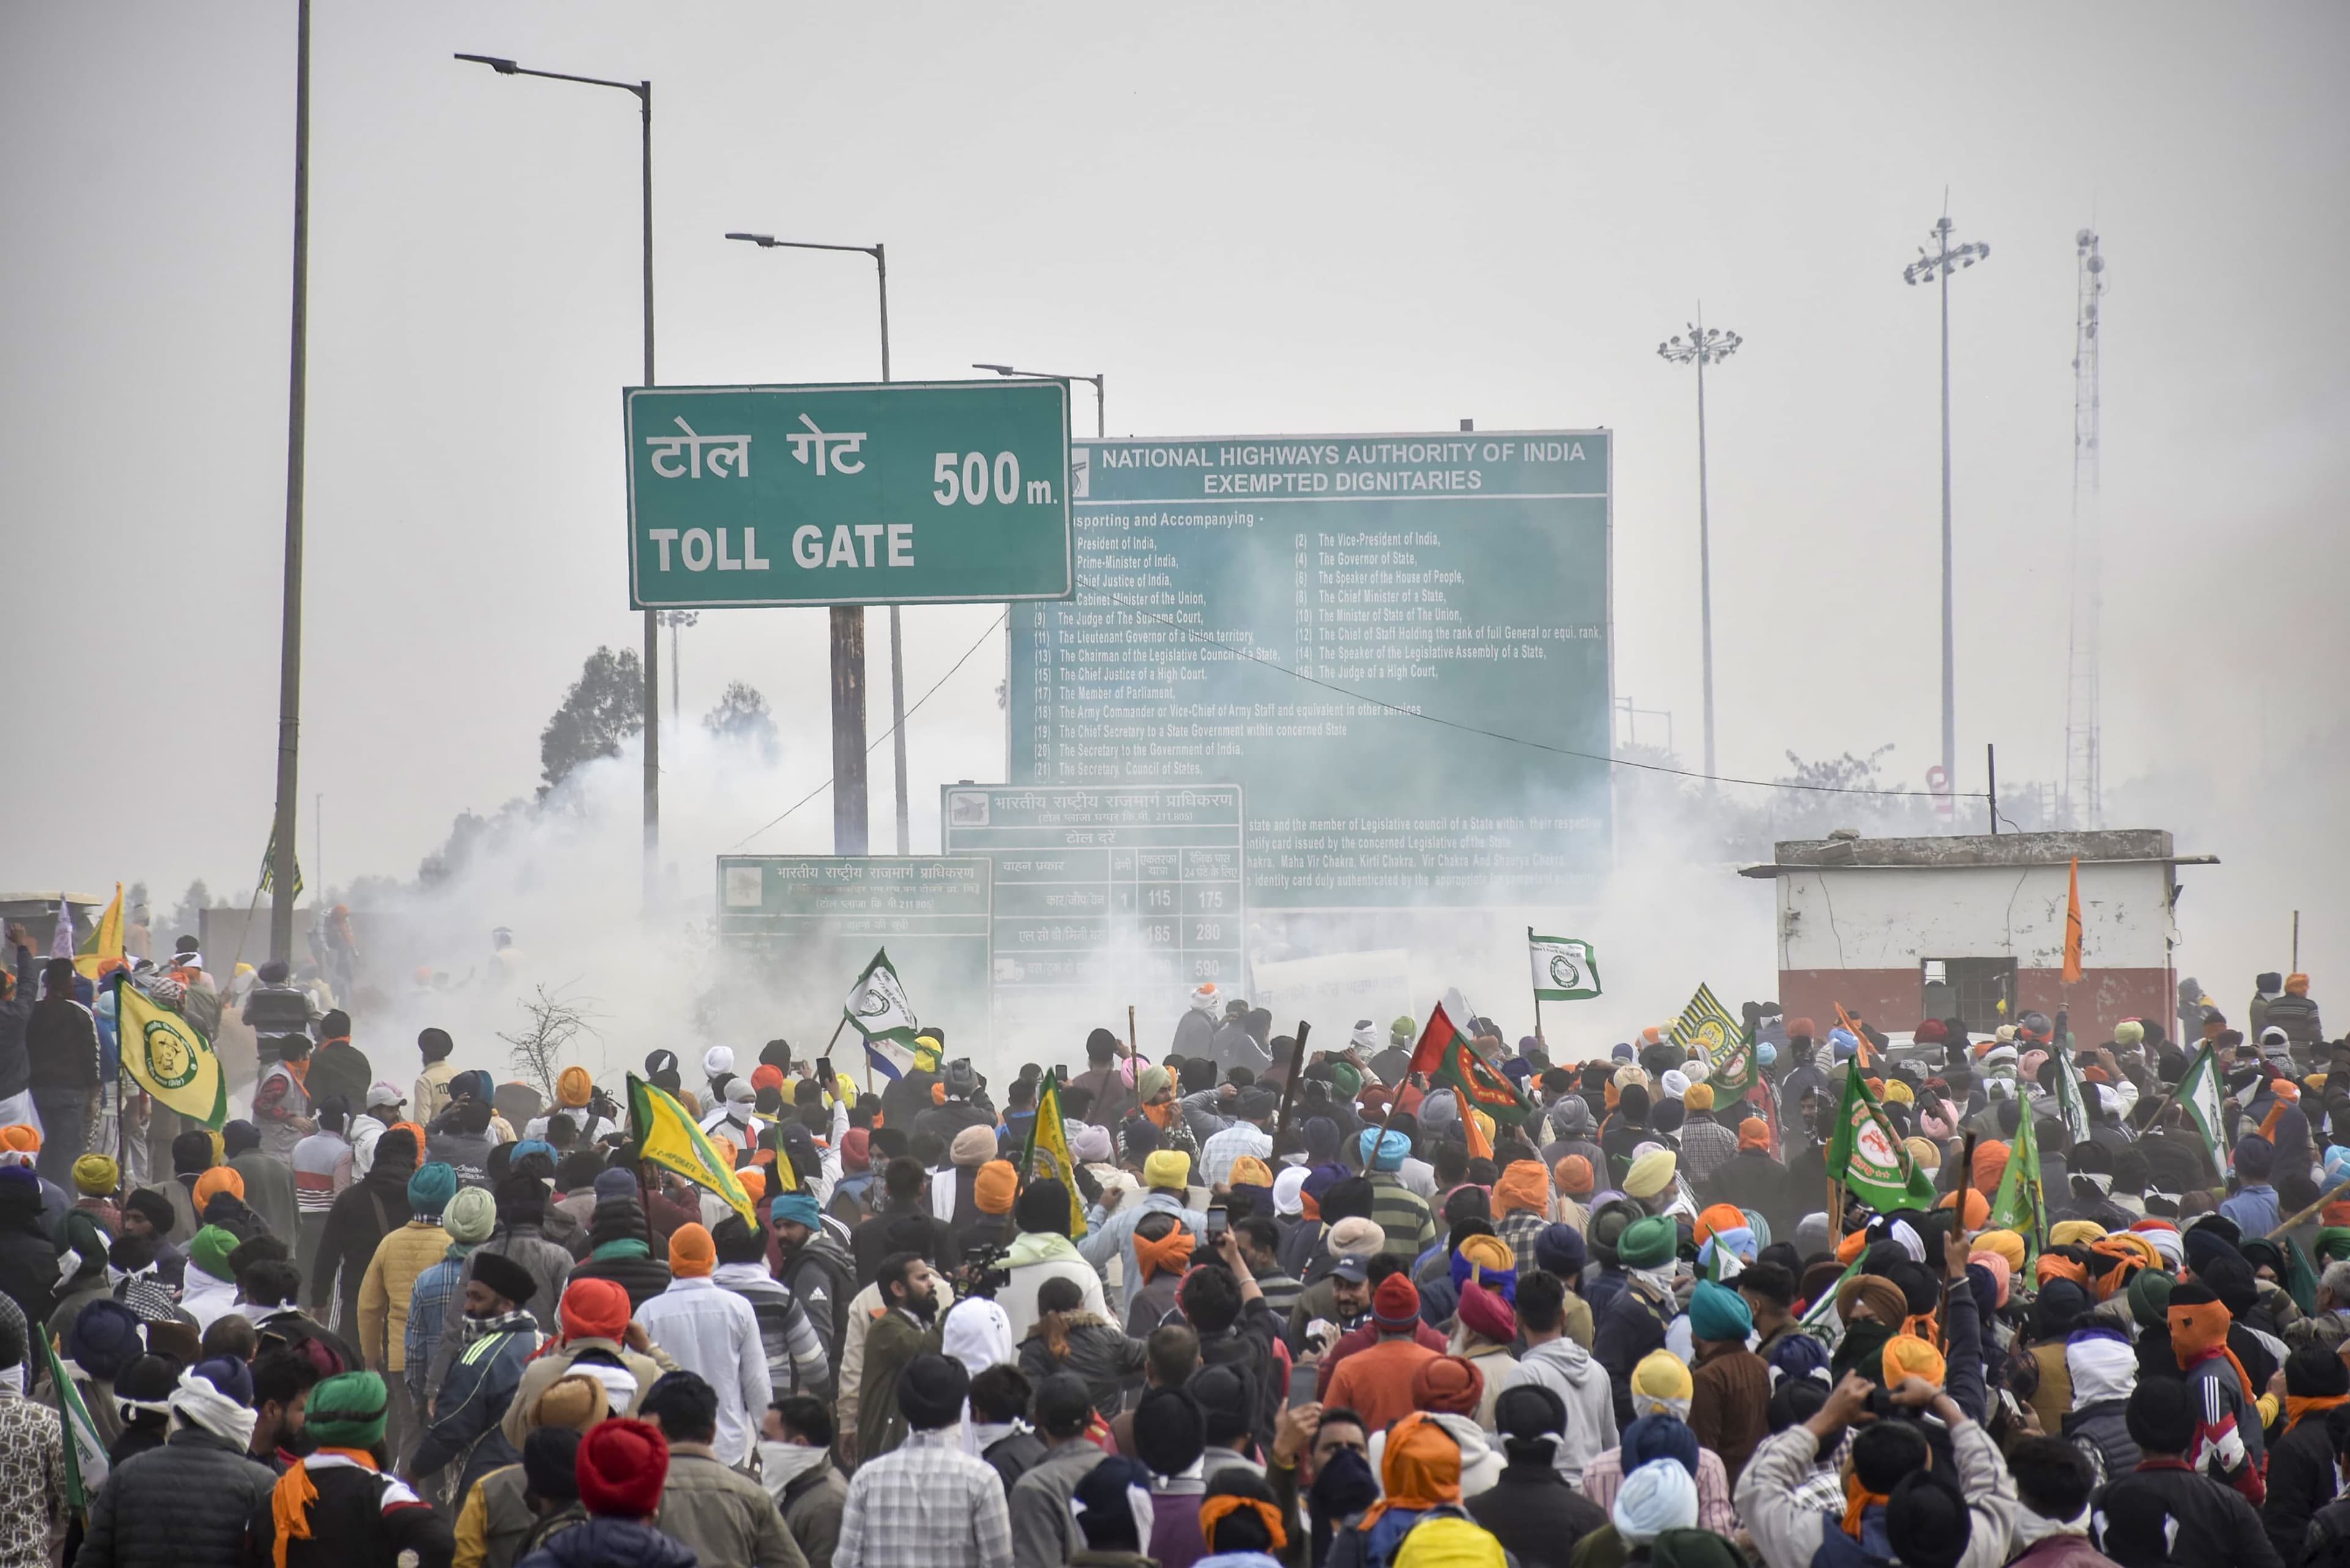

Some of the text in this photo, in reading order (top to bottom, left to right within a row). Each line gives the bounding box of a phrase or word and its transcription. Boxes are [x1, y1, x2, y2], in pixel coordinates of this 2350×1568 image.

[646, 413, 867, 479] टोल गेट
[1103, 443, 1585, 468] NATIONAL HIGHWAYS AUTHORITY OF INDIA
[933, 451, 1058, 506] 500 m.
[1205, 471, 1481, 493] EXEMPTED DIGNITARIES
[1135, 513, 1156, 526] and
[1161, 513, 1253, 528] Accompanying
[649, 523, 914, 572] TOLL GATE
[1078, 536, 1156, 550] President of India,
[1296, 532, 1440, 549] (2) The Vice-President of India,
[1078, 554, 1177, 568] Prime-Minister of India,
[1296, 551, 1417, 568] (4) The Governor of State,
[1077, 573, 1171, 587] Chief Justice of India,
[1296, 570, 1464, 588] (6) The Speaker of the House of People,
[1077, 593, 1110, 606] Cabinet
[1113, 593, 1147, 605] Minister
[1151, 592, 1159, 604] of
[1162, 592, 1174, 604] the
[1179, 592, 1206, 605] Union,
[1296, 589, 1445, 606] (8) The Chief Minister of a State,
[1035, 610, 1203, 628] (9) The Judge of The Supreme Court,
[1296, 607, 1461, 626] (10) The Minister of State of The Union,
[1034, 629, 1253, 647] (11) The Lieutenant Governor of a Union territory,
[1296, 625, 1601, 643] (12) The Chief of Staff Holding the rank of full General or equi. rank,
[1035, 649, 1051, 666] (13)
[1061, 649, 1075, 662] The
[1079, 649, 1119, 662] Chairman
[1122, 648, 1131, 662] of
[1133, 649, 1146, 662] the
[1150, 649, 1197, 661] Legislative
[1201, 648, 1234, 661] Council
[1237, 647, 1246, 660] of
[1256, 648, 1280, 660] State,
[1035, 667, 1207, 684] (15) The Chief Justice of a High Court,
[1035, 685, 1175, 703] (17) The Member of Parliament,
[994, 791, 1233, 812] भारतीय राष्ट्रीय राजमार्ग प्राधिकरण
[1250, 819, 1270, 831] state
[1275, 818, 1289, 831] and
[1293, 818, 1306, 831] the
[1310, 818, 1345, 831] member
[1349, 818, 1357, 831] of
[1362, 818, 1410, 833] Legislative
[1414, 818, 1446, 830] council
[1450, 817, 1459, 830] of
[1471, 816, 1493, 829] State
[1065, 830, 1094, 844] टोल
[777, 863, 974, 881] भारतीय राष्ट्रीय राजमार्ग प्राधिकरण
[1004, 862, 1064, 872] वाहन प्रकार
[1148, 889, 1171, 906] 115
[1199, 890, 1223, 908] 175
[1146, 925, 1170, 941] 185
[1196, 923, 1220, 941] 280
[1196, 960, 1220, 976] 590
